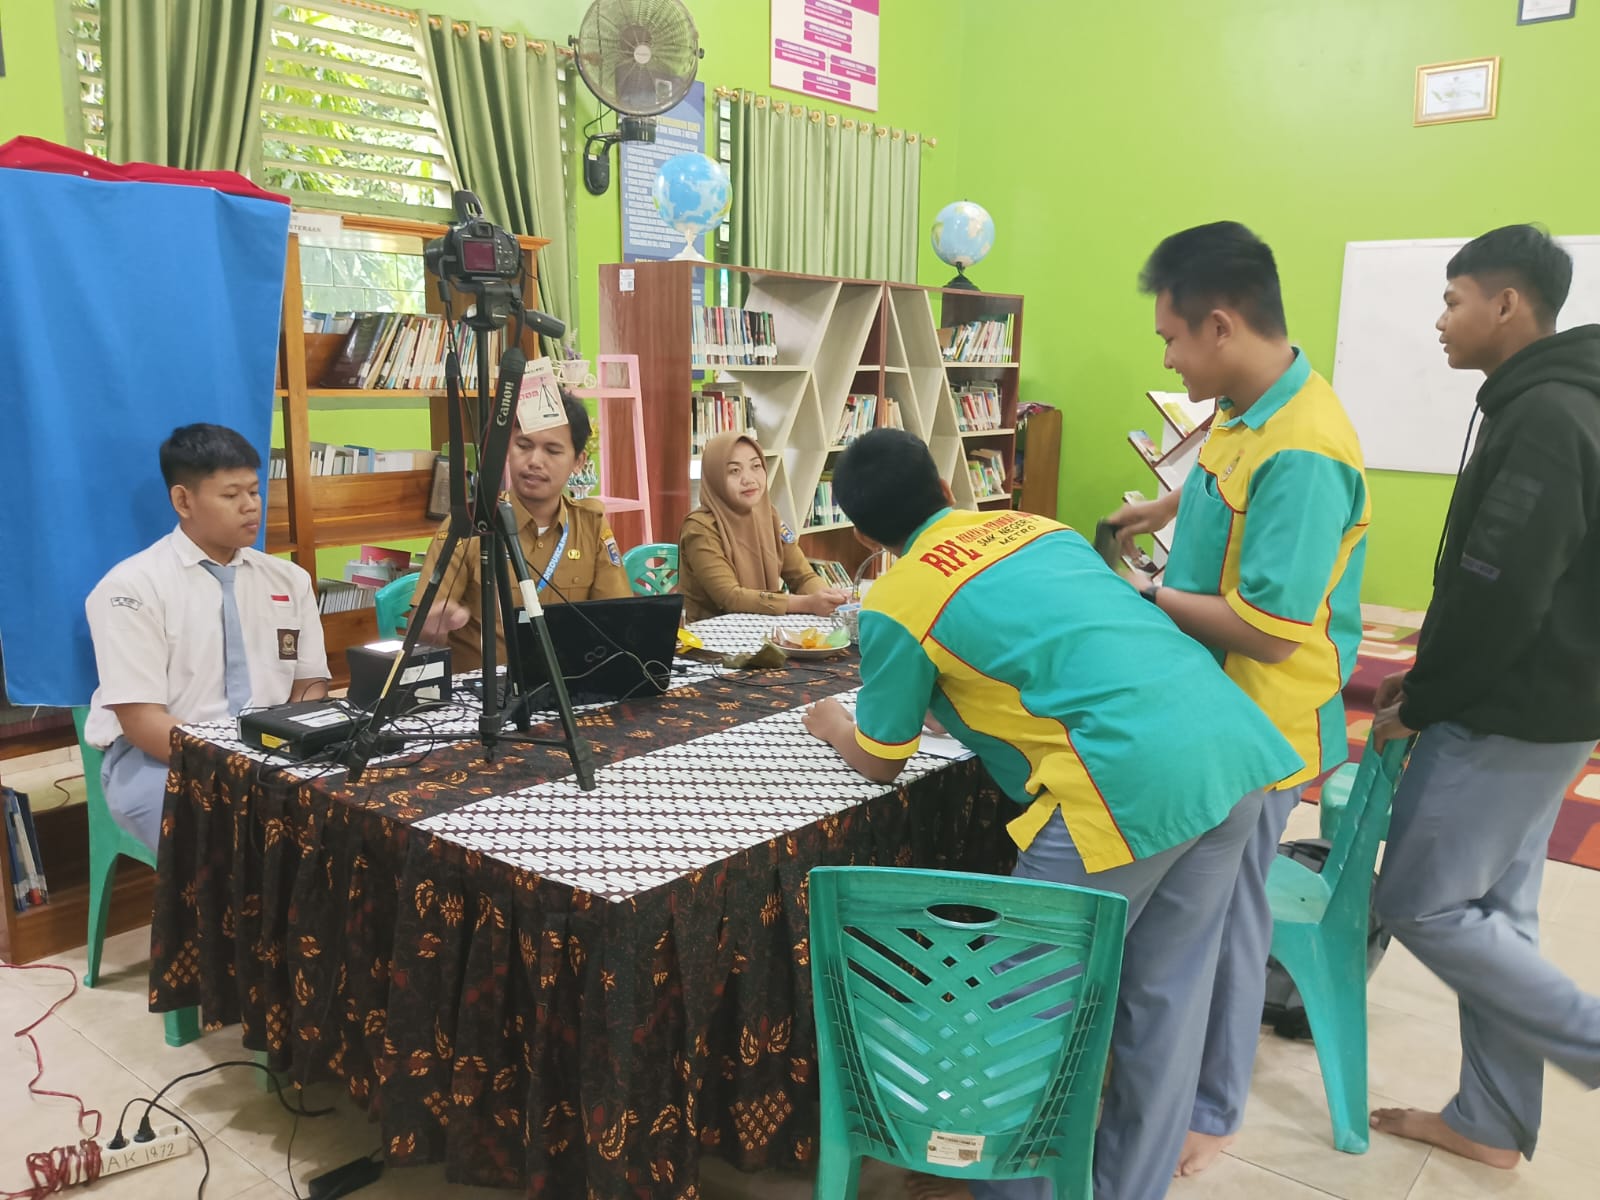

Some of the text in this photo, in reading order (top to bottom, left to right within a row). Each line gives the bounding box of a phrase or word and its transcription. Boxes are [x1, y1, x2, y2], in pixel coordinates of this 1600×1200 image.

[496, 381, 515, 427] Canon
[976, 533, 997, 547] SMK
[997, 524, 1037, 546] METRO
[919, 539, 984, 578] RPL
